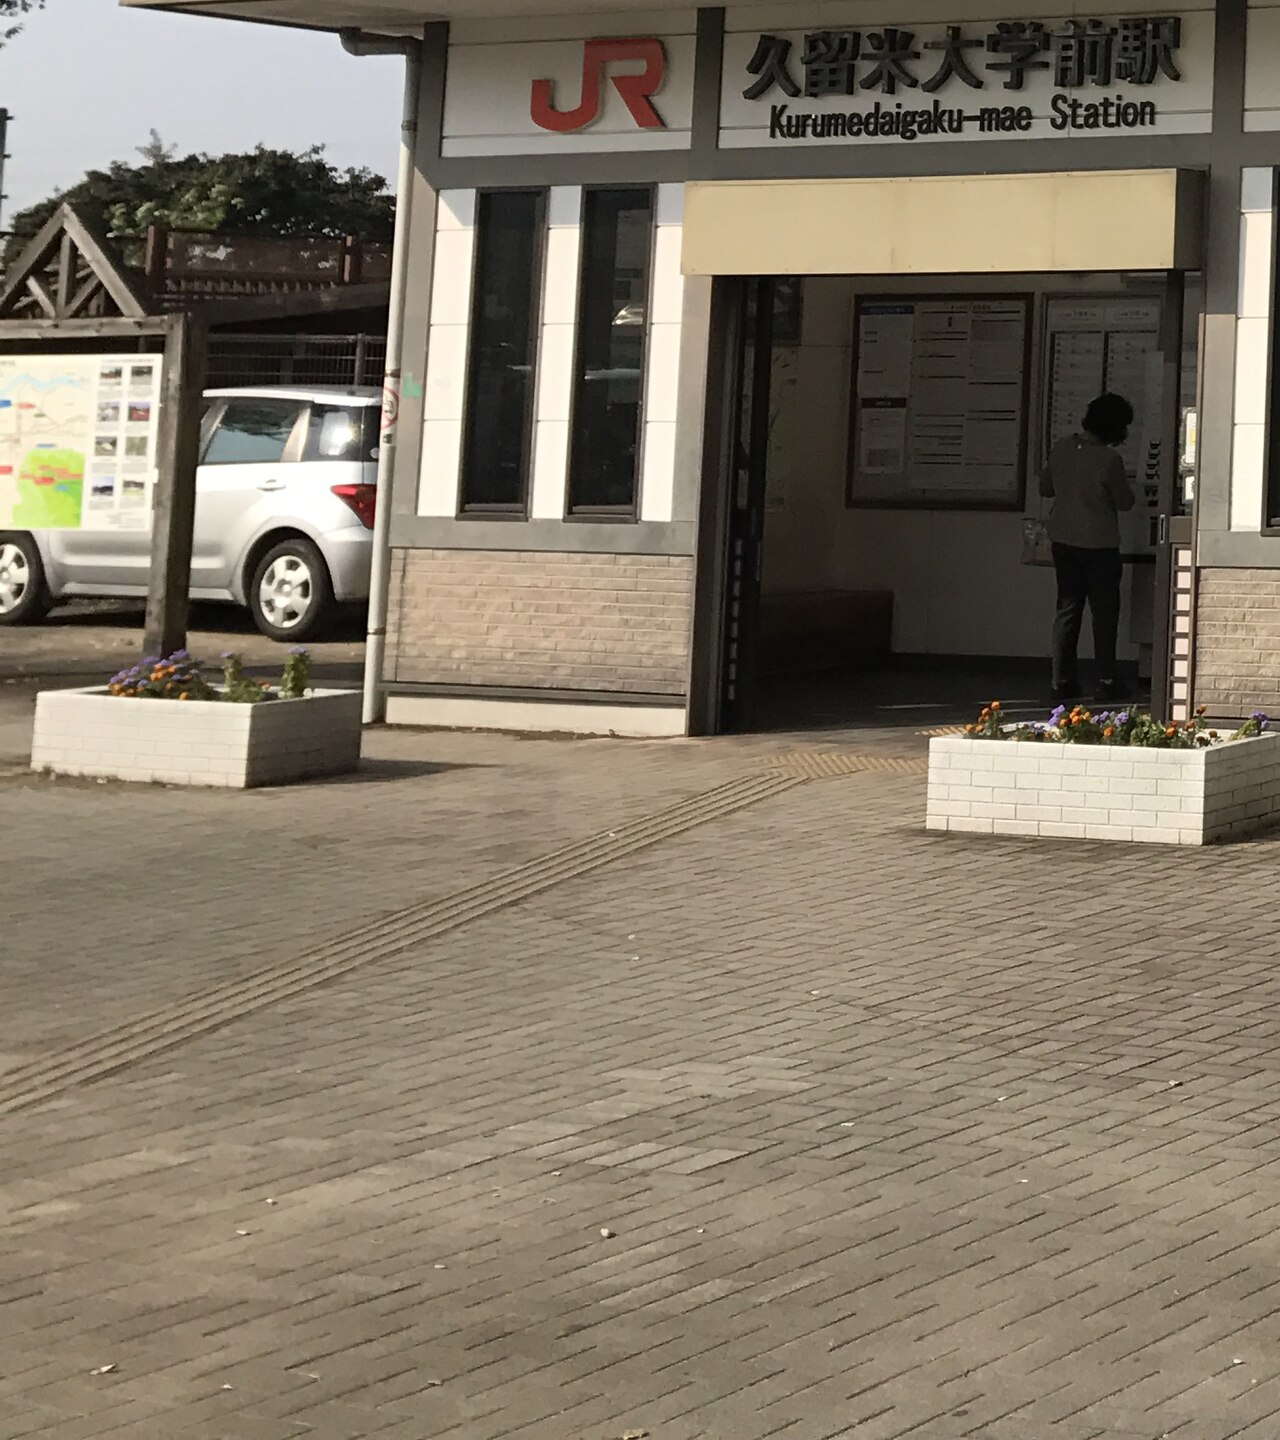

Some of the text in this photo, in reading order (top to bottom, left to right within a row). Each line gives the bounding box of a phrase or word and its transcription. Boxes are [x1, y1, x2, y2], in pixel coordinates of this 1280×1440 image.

[531, 38, 666, 132] JR
[742, 17, 1182, 100] 久留米大学前駅
[769, 93, 1156, 140] Kurumedaigaku-mae Station
